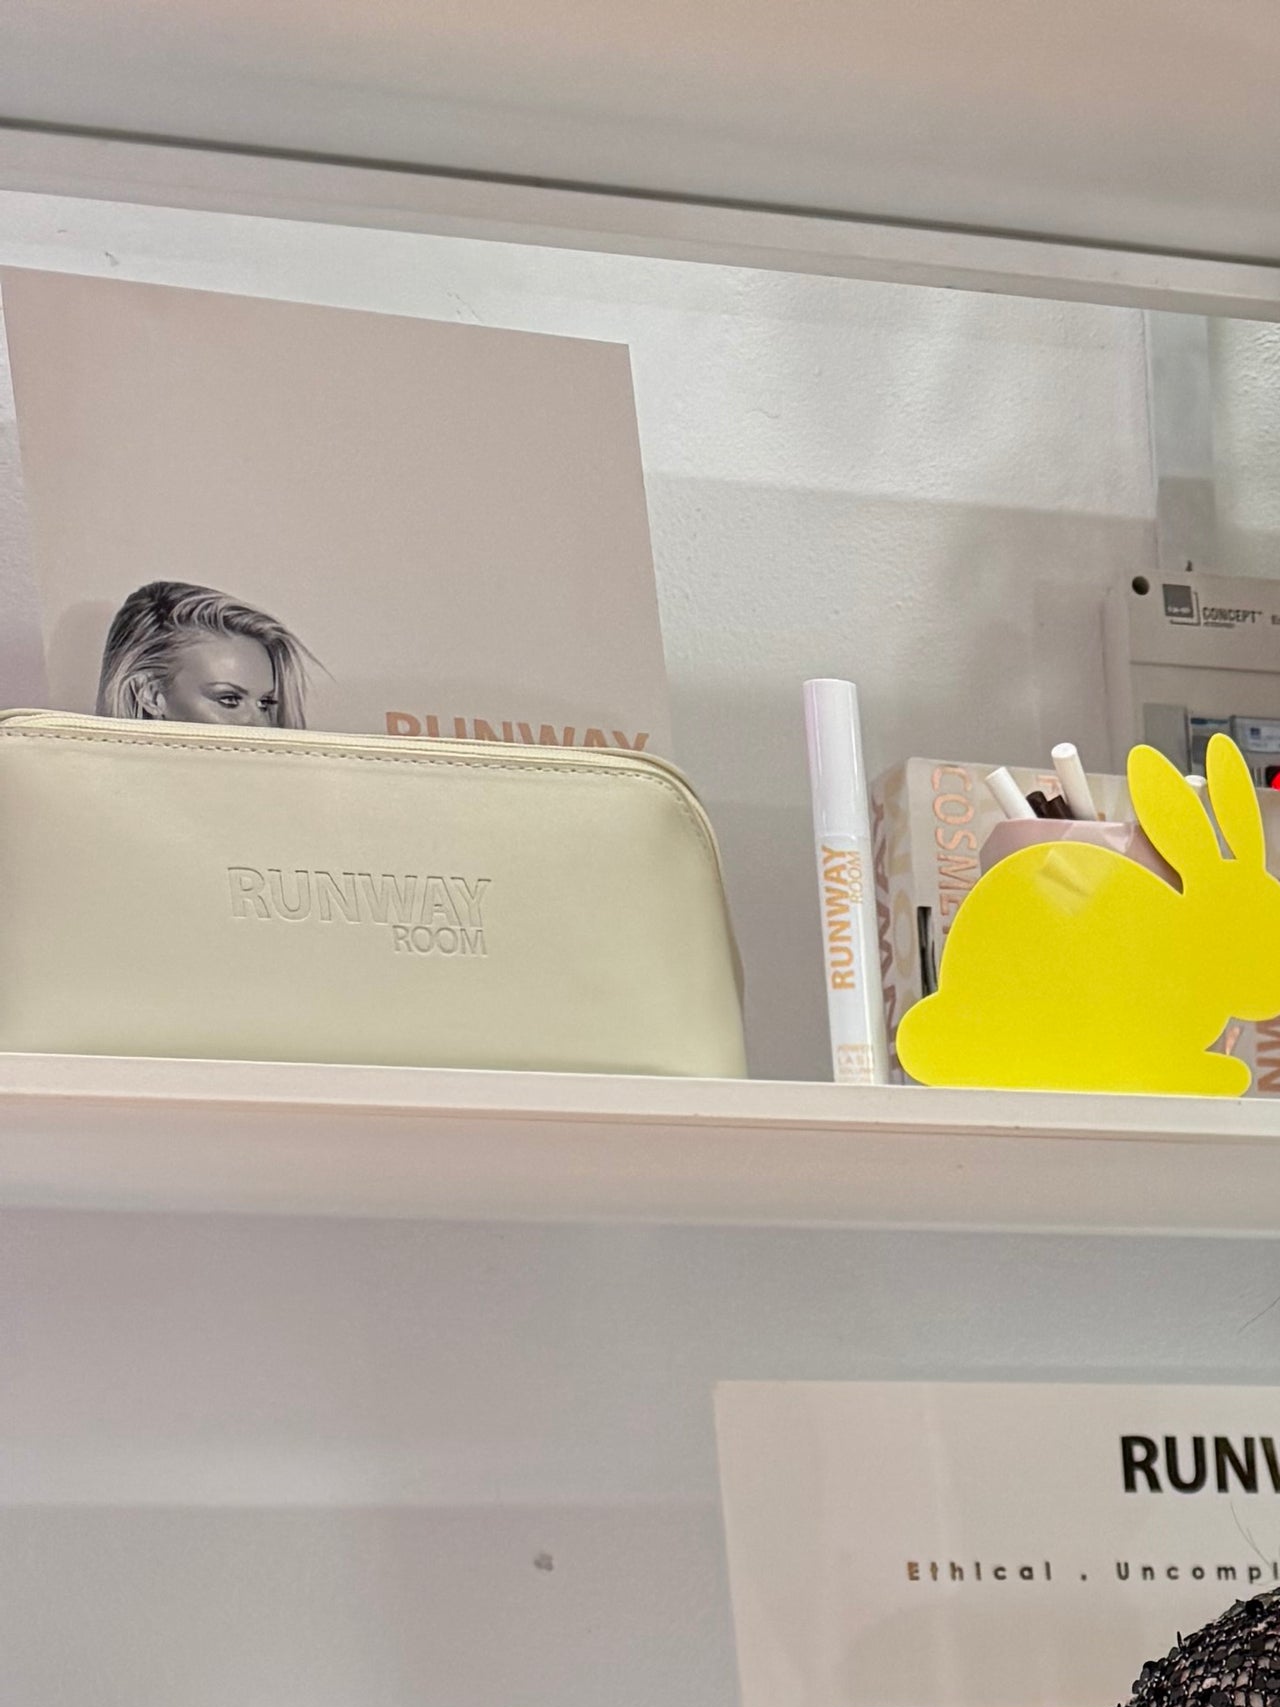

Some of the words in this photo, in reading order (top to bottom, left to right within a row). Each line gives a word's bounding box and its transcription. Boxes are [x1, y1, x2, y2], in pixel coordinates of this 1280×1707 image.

[227, 866, 491, 929] RUNWAY
[822, 847, 855, 991] RUNWAY
[392, 924, 489, 957] ROOM
[907, 1561, 1052, 1582] Ethical
